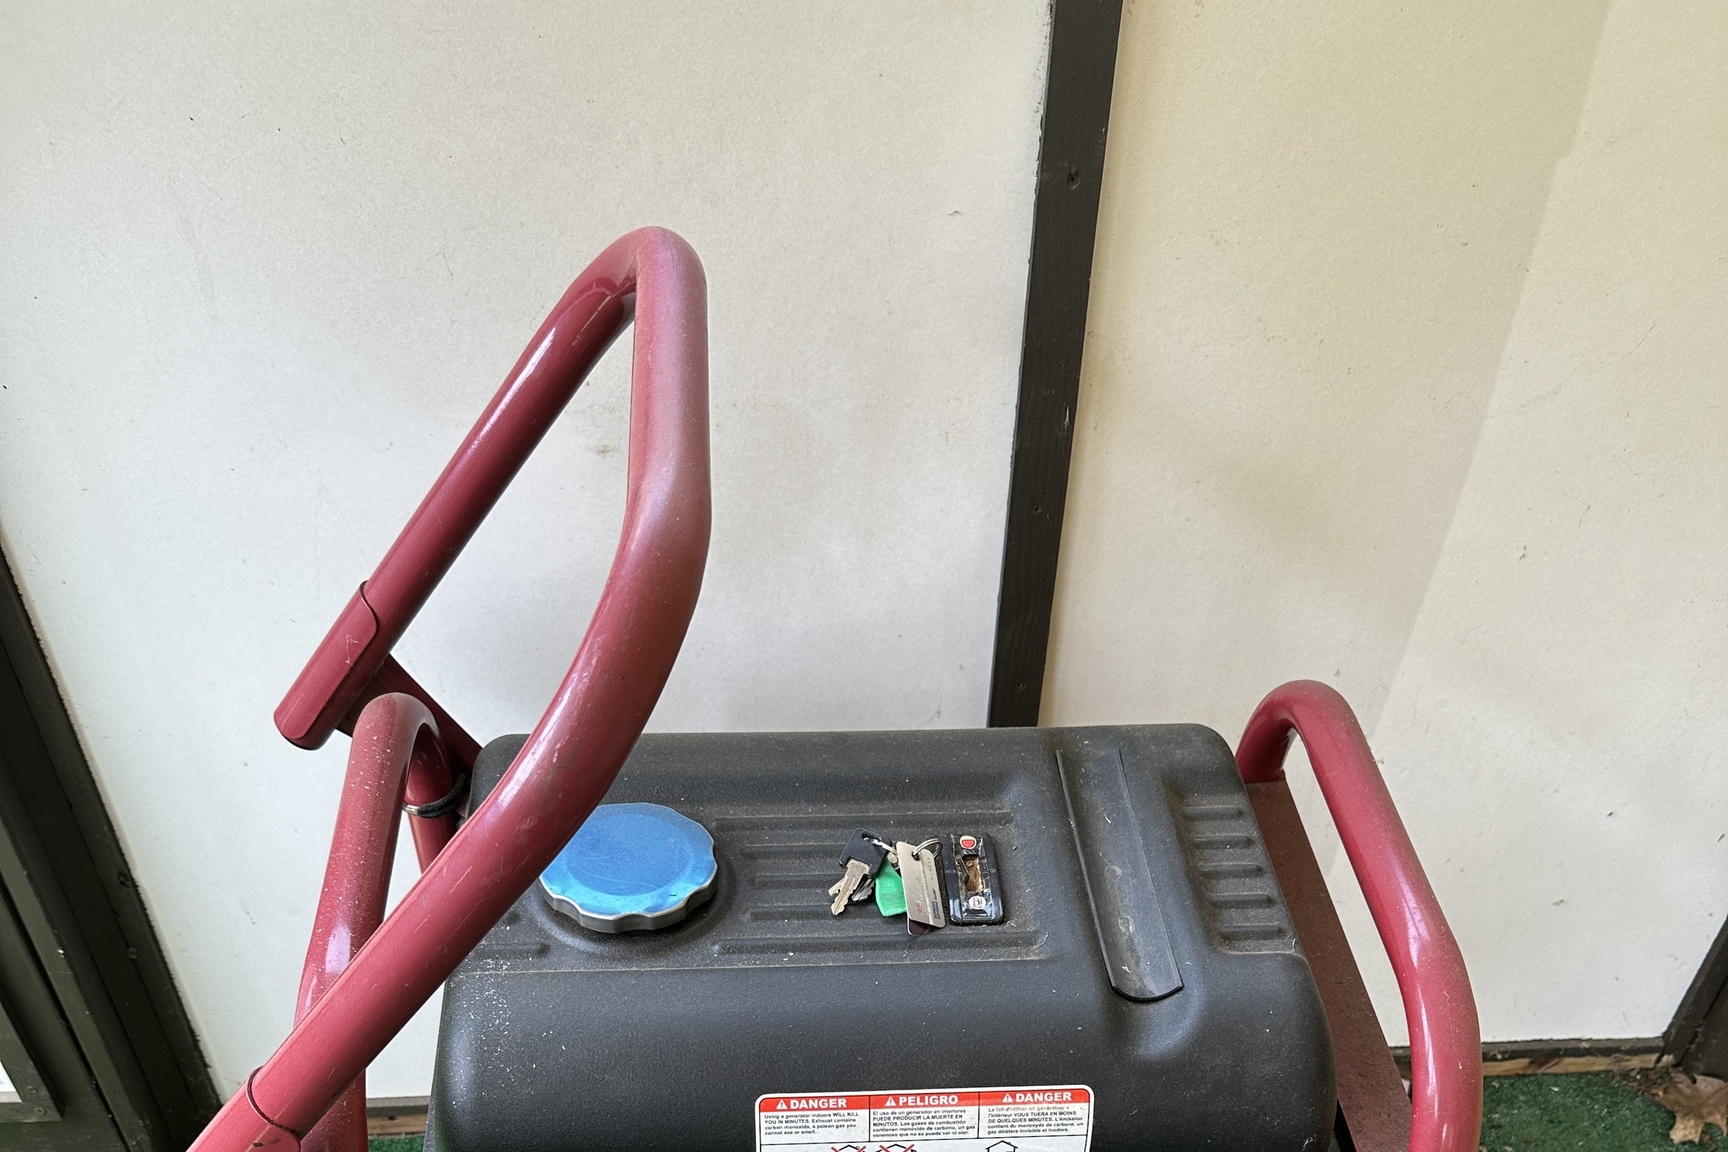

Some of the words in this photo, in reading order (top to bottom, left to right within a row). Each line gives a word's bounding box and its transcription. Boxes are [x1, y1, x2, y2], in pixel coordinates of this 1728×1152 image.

[899, 1095, 958, 1106] PELIGRO
[1016, 1092, 1072, 1102] DANGER
[790, 1099, 847, 1109] DANGER
